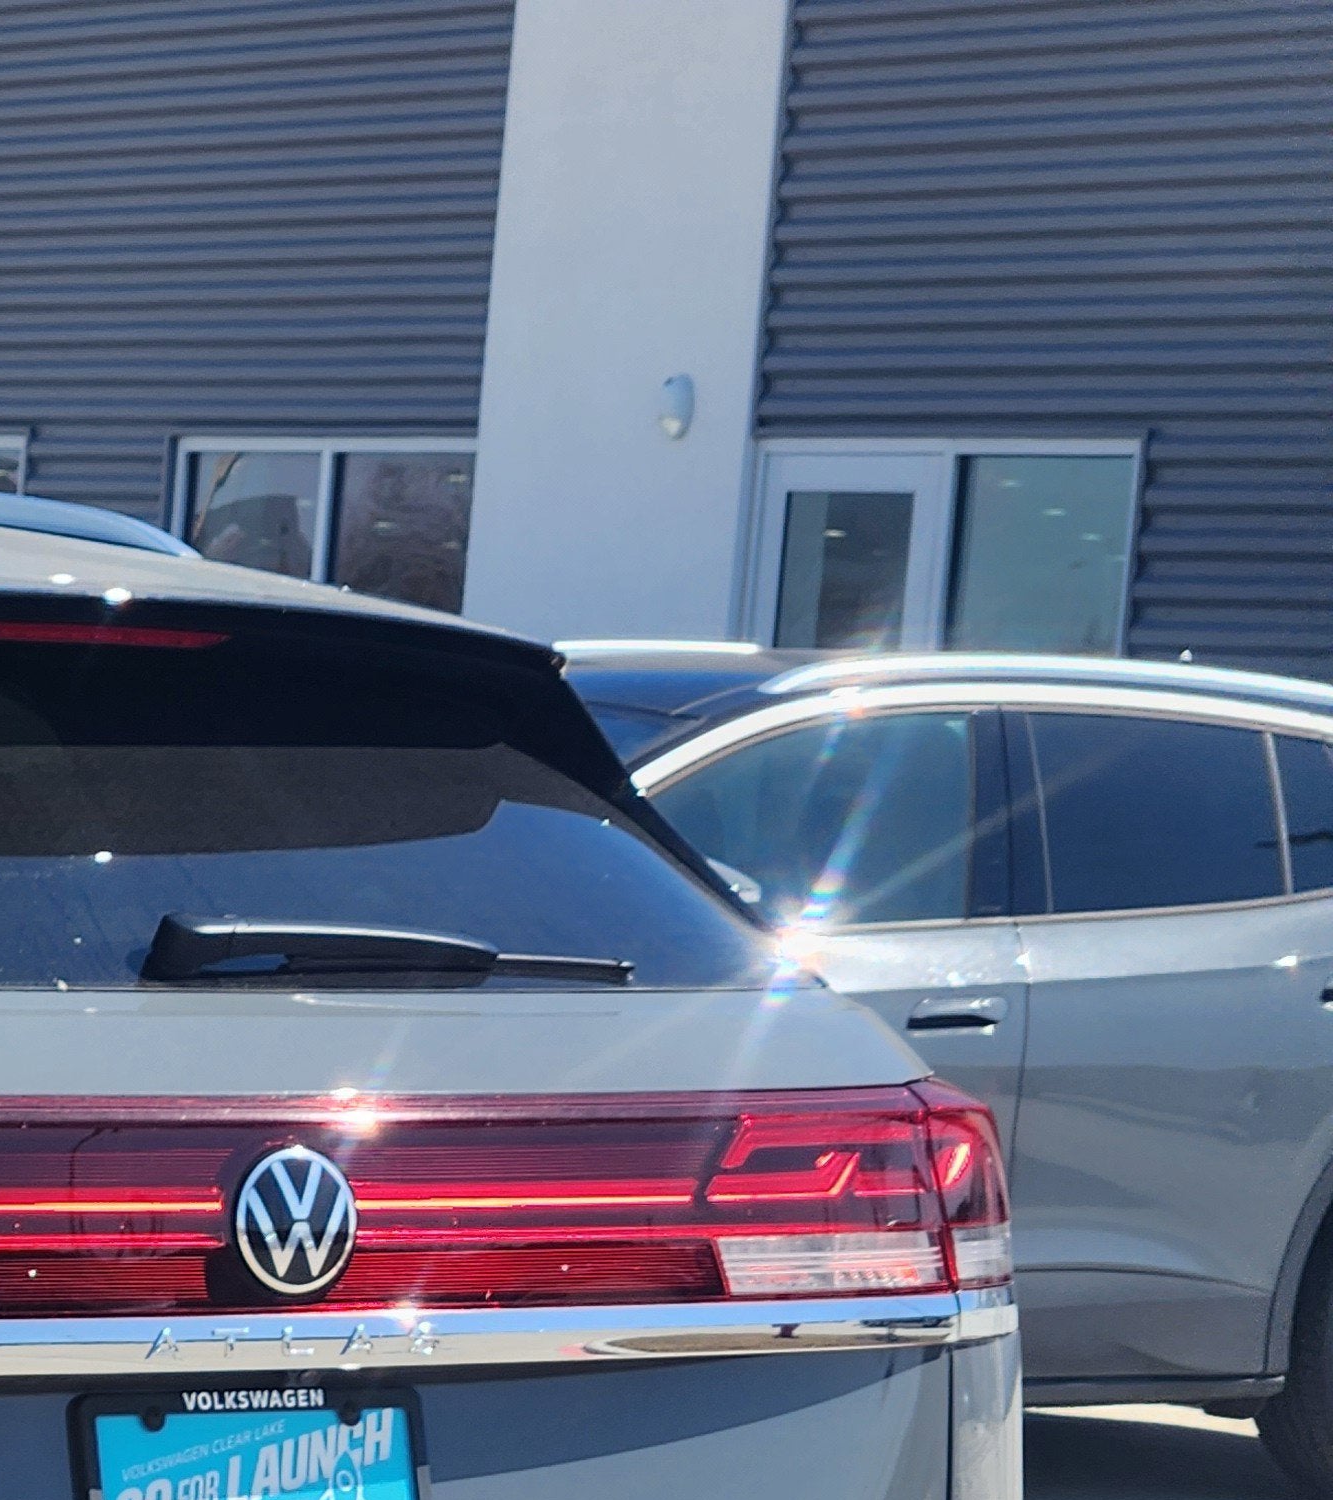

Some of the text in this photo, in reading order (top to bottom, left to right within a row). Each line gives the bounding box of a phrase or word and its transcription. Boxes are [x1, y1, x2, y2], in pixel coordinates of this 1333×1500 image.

[145, 1321, 439, 1360] ATLAS
[181, 1388, 325, 1411] VOLKSWAGEN
[121, 1418, 287, 1483] VOLKSWAGEN CLEAR LAKE
